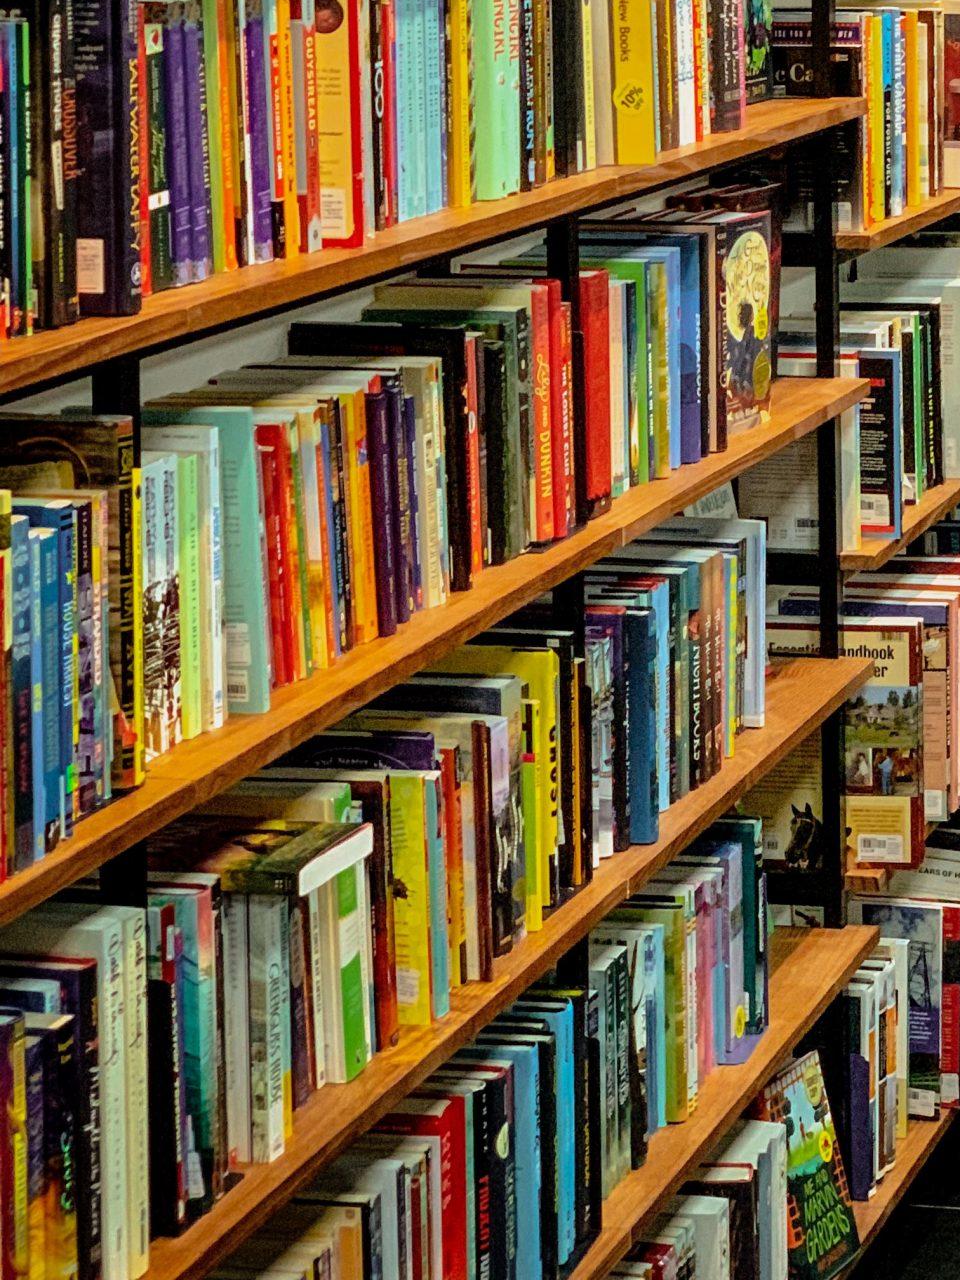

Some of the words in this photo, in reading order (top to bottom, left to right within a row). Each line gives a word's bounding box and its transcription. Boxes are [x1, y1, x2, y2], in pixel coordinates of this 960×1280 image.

[620, 27, 630, 62] Books
[620, 86, 644, 109] 10%
[535, 354, 550, 402] Lily
[540, 430, 551, 498] DUNKIN
[62, 601, 73, 650] HOUSE
[92, 580, 103, 686] STRANDED
[942, 870, 953, 878] OF
[269, 963, 280, 1056] GREENGLASS
[270, 1060, 281, 1104] HOUSE
[804, 1182, 840, 1226] MARVIN
[806, 1204, 851, 1264] GARDENS
